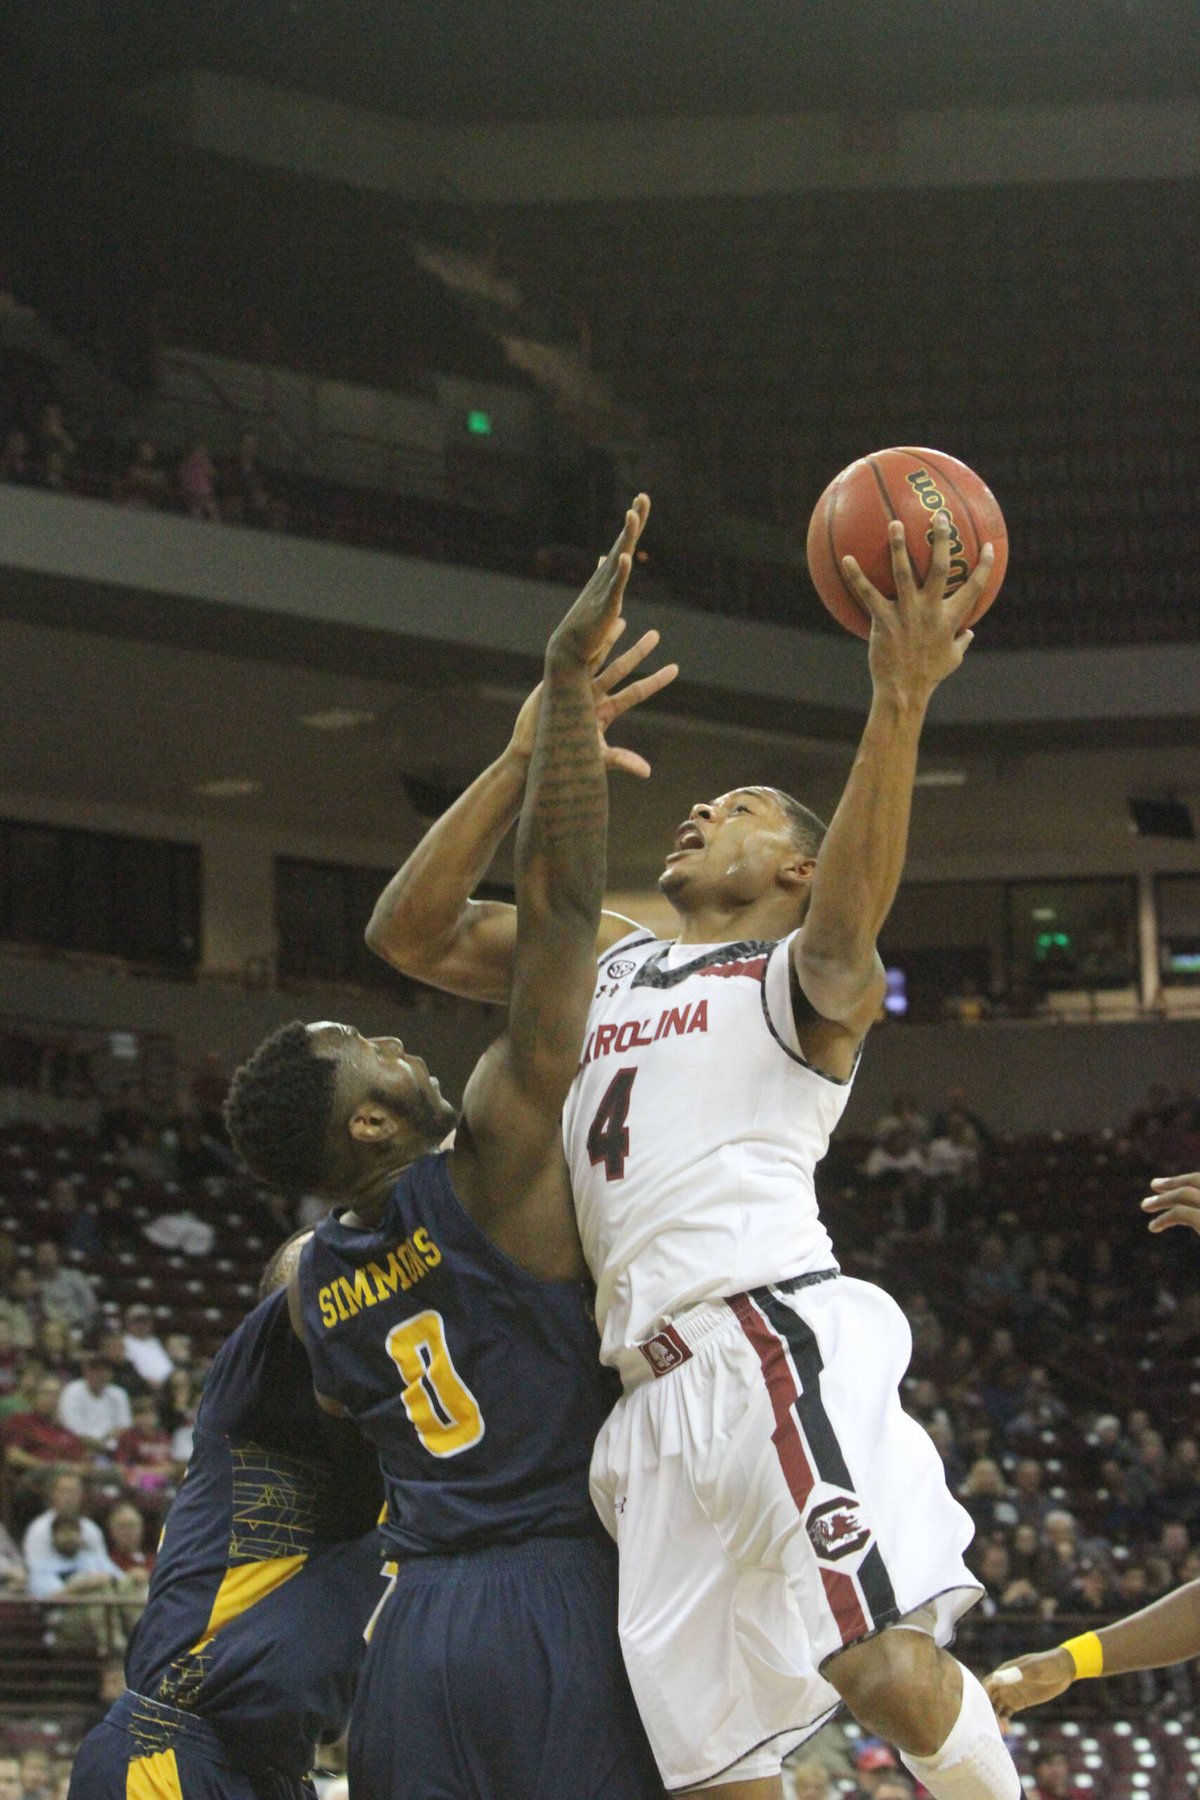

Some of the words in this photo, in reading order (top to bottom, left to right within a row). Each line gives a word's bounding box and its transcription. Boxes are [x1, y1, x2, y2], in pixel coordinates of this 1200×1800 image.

[577, 999, 708, 1077] AROLINA
[586, 1066, 639, 1183] 4
[318, 1226, 441, 1329] SIMMONS
[385, 1309, 486, 1459] 0
